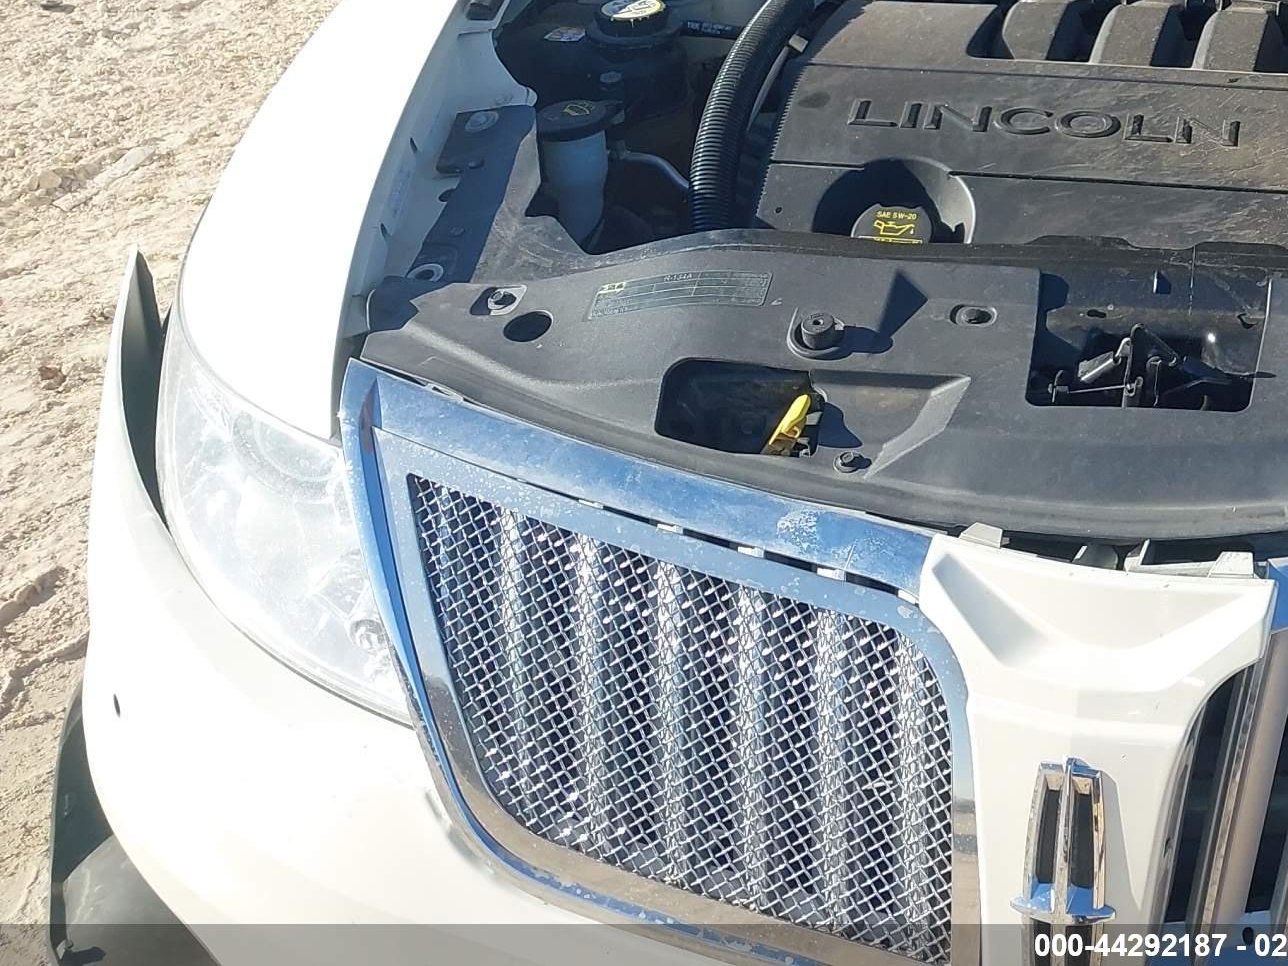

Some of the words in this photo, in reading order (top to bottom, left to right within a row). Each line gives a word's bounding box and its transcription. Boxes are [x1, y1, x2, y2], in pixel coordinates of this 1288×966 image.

[847, 98, 1241, 147] LINCOLN
[876, 211, 891, 219] SAE
[892, 212, 917, 220] 5W-20
[663, 273, 693, 282] R-134A
